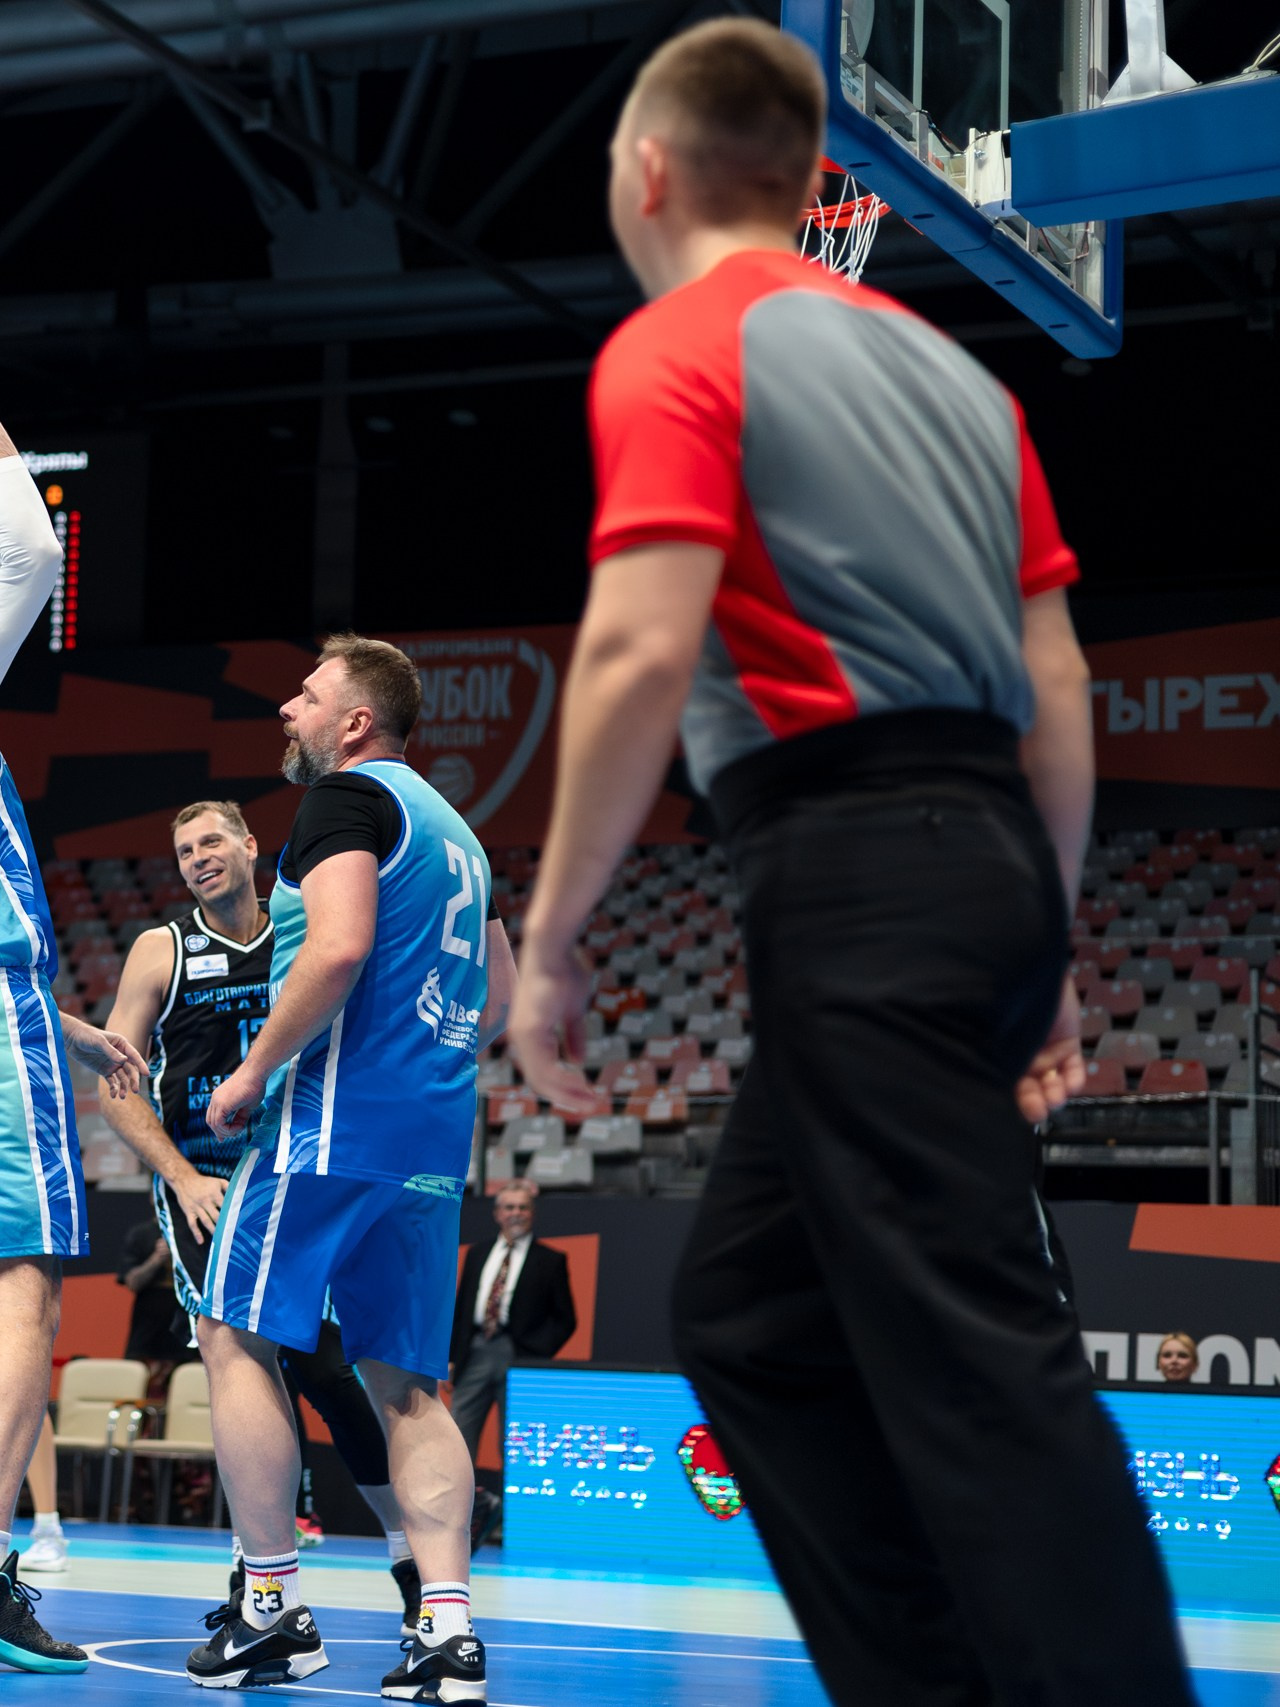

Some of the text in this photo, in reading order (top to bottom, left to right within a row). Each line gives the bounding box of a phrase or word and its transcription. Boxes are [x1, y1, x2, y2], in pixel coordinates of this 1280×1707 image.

[420, 664, 514, 721] УБОК
[440, 837, 487, 969] 21
[252, 1589, 284, 1615] 23
[461, 1641, 478, 1651] NIKE
